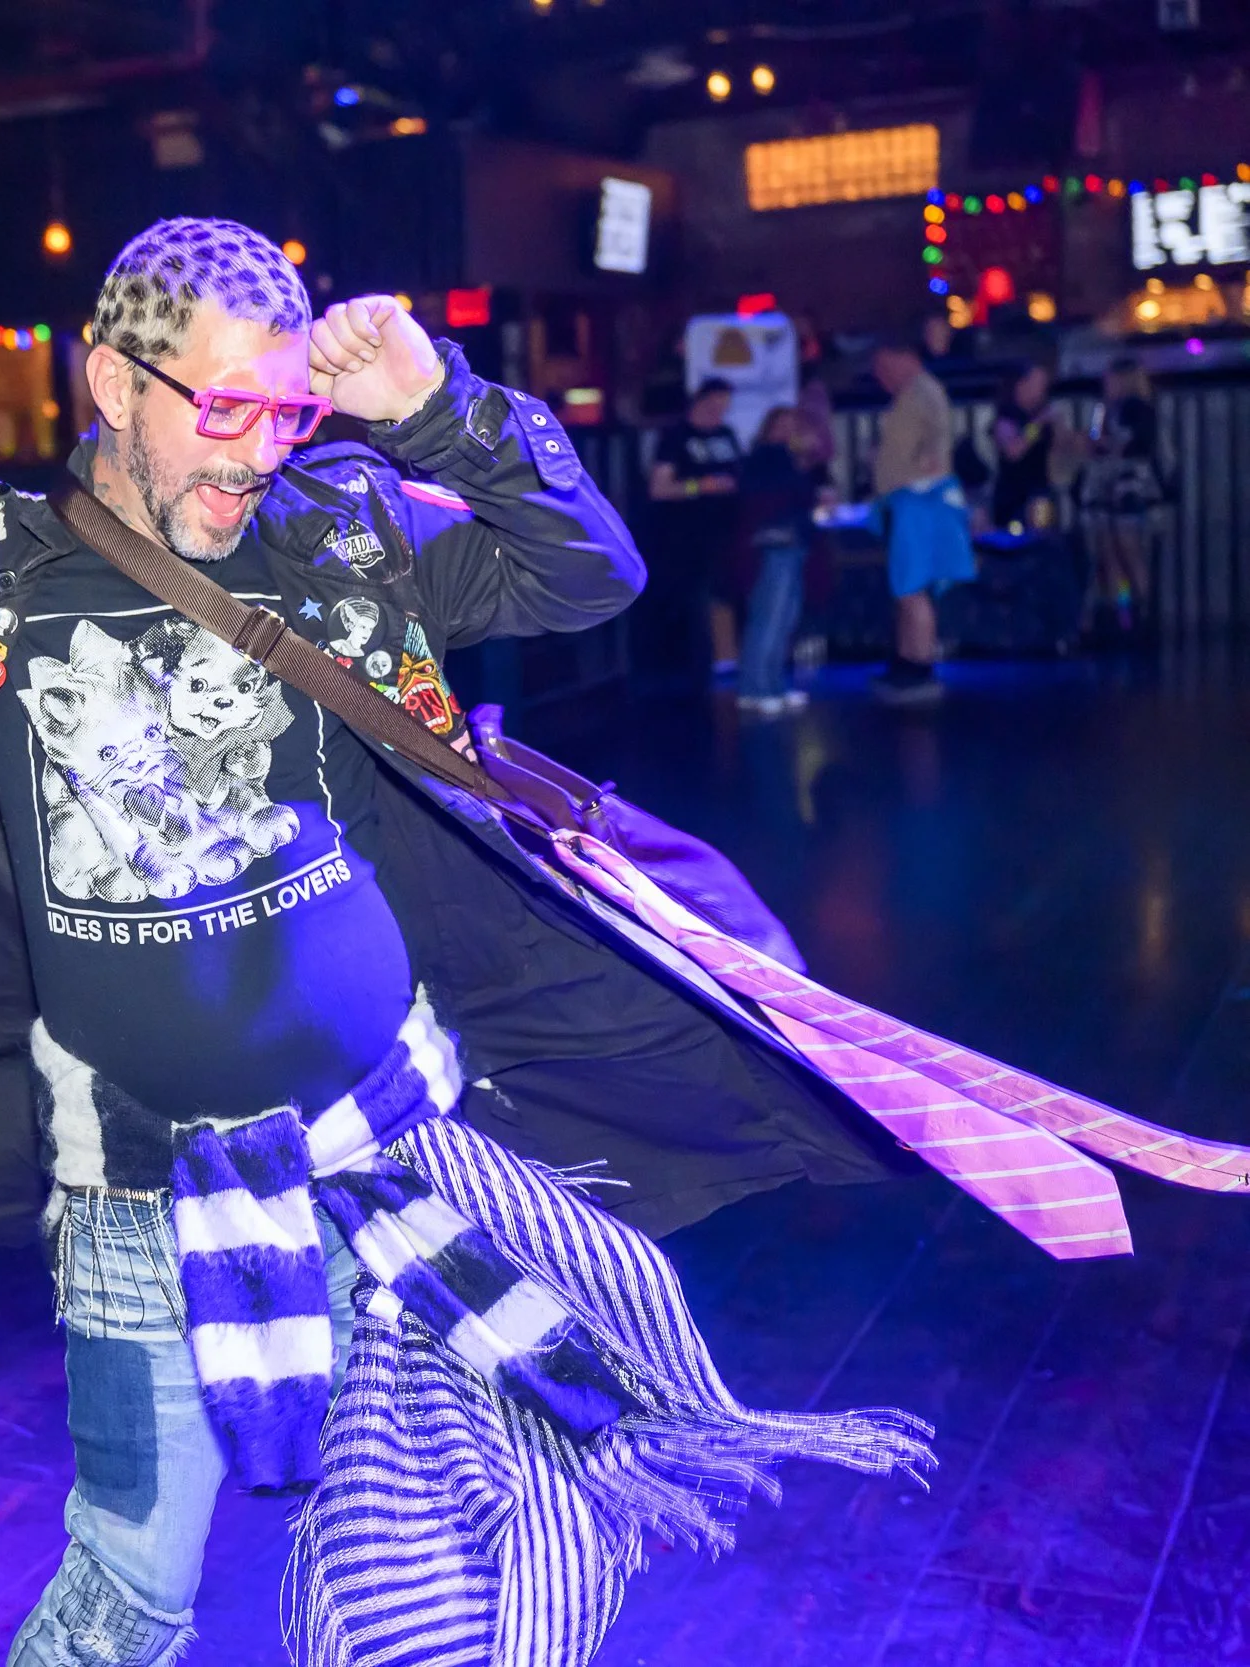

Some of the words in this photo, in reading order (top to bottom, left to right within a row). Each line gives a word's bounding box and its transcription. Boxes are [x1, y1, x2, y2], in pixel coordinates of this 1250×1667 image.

[47, 911, 103, 942] IDLES
[109, 923, 131, 945] IS
[139, 919, 193, 945] FOR
[199, 901, 258, 936] THE
[261, 858, 352, 918] LOVERS
